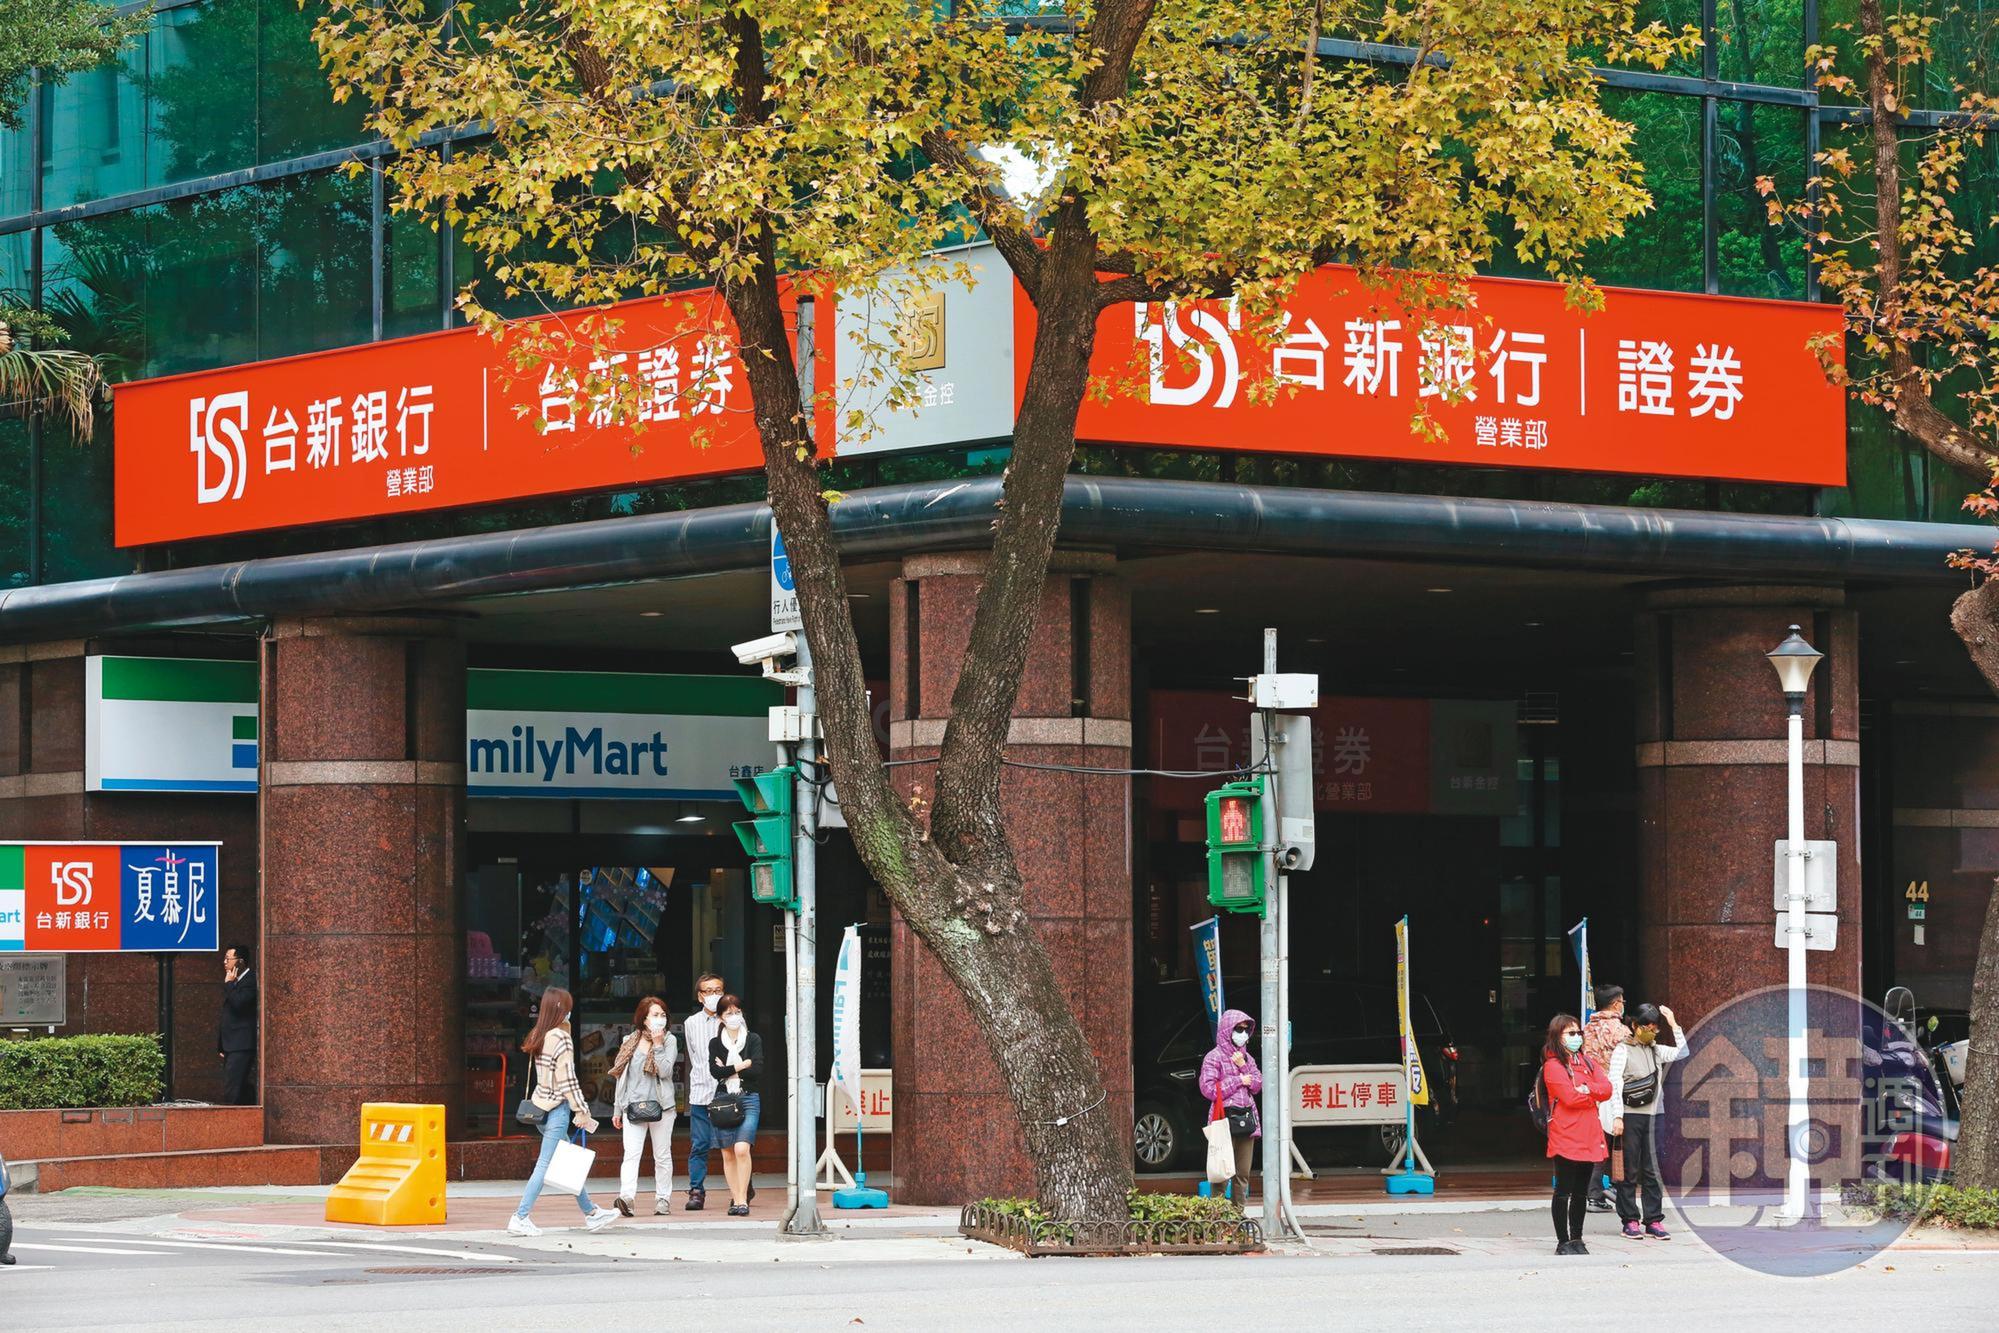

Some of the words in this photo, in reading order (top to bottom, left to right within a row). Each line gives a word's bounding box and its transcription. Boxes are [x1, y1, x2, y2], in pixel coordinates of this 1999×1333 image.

[1269, 311, 1548, 407] 台新銀行
[1618, 340, 1744, 420] 證券
[262, 386, 434, 475] 台新銀行
[1475, 415, 1548, 450] 營業部
[386, 465, 434, 498] 營業部
[470, 725, 668, 782] milyMart
[729, 765, 764, 778] 台鑫店
[128, 848, 206, 943] 夏慕尼
[1905, 880, 1929, 902] 44
[36, 911, 109, 930] 台新銀行
[1302, 1082, 1397, 1109] 禁止停車
